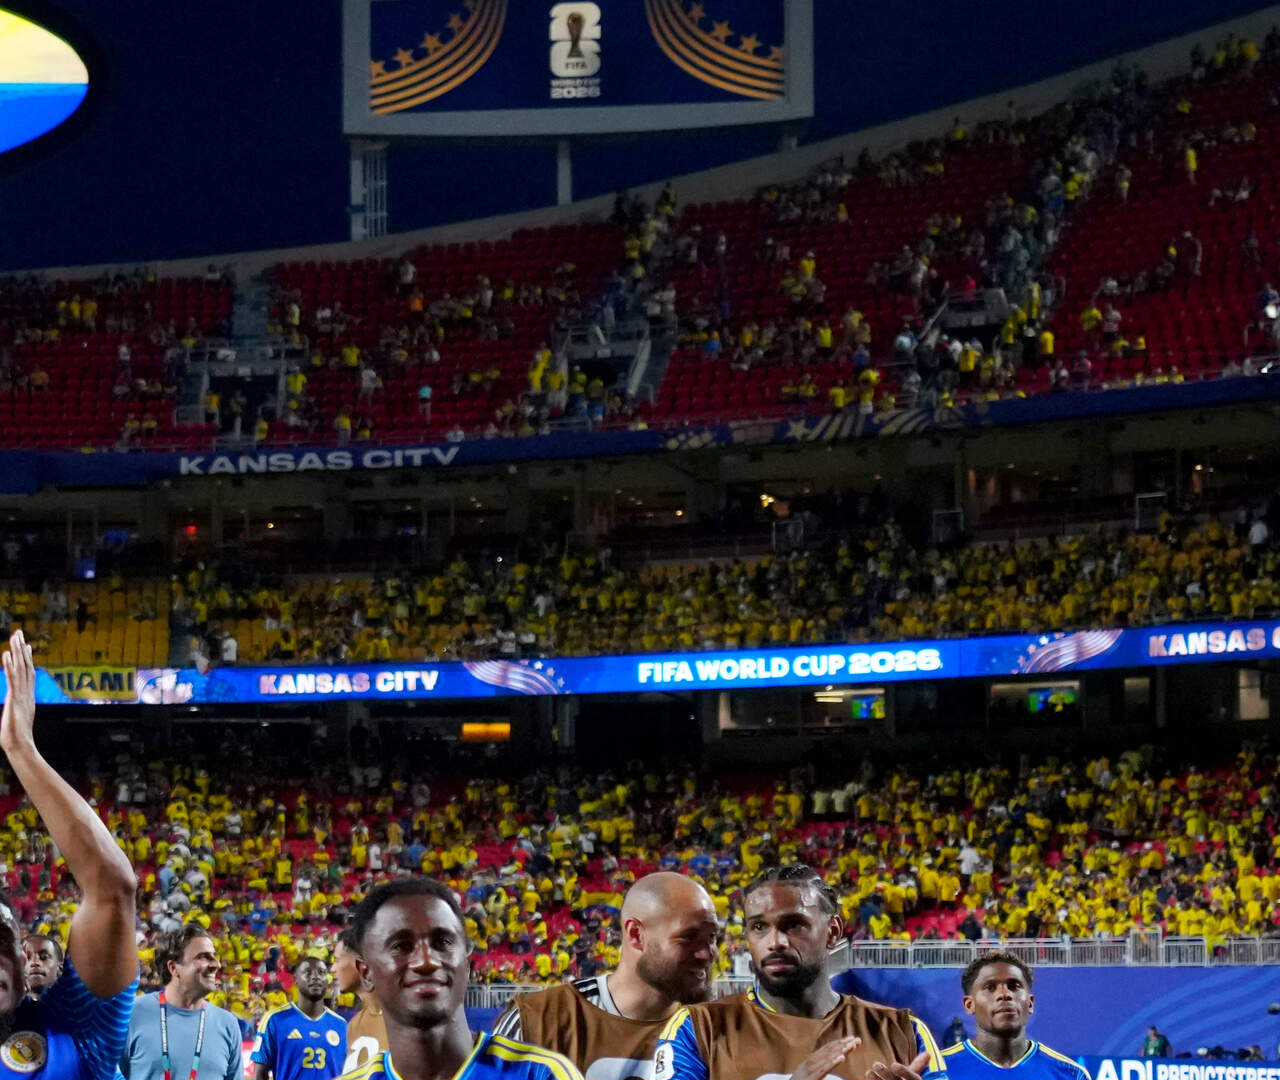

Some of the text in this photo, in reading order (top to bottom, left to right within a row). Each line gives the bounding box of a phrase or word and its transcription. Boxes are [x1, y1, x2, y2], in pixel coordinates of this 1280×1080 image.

[565, 62, 588, 71] FIFA
[550, 86, 601, 99] 2026
[180, 447, 459, 476] KANSAS CITY
[1149, 628, 1266, 657] KANSAS
[638, 649, 941, 683] FIFA WORLD CUP 2026
[259, 670, 439, 694] KANSAS CITY
[303, 1046, 326, 1069] 23
